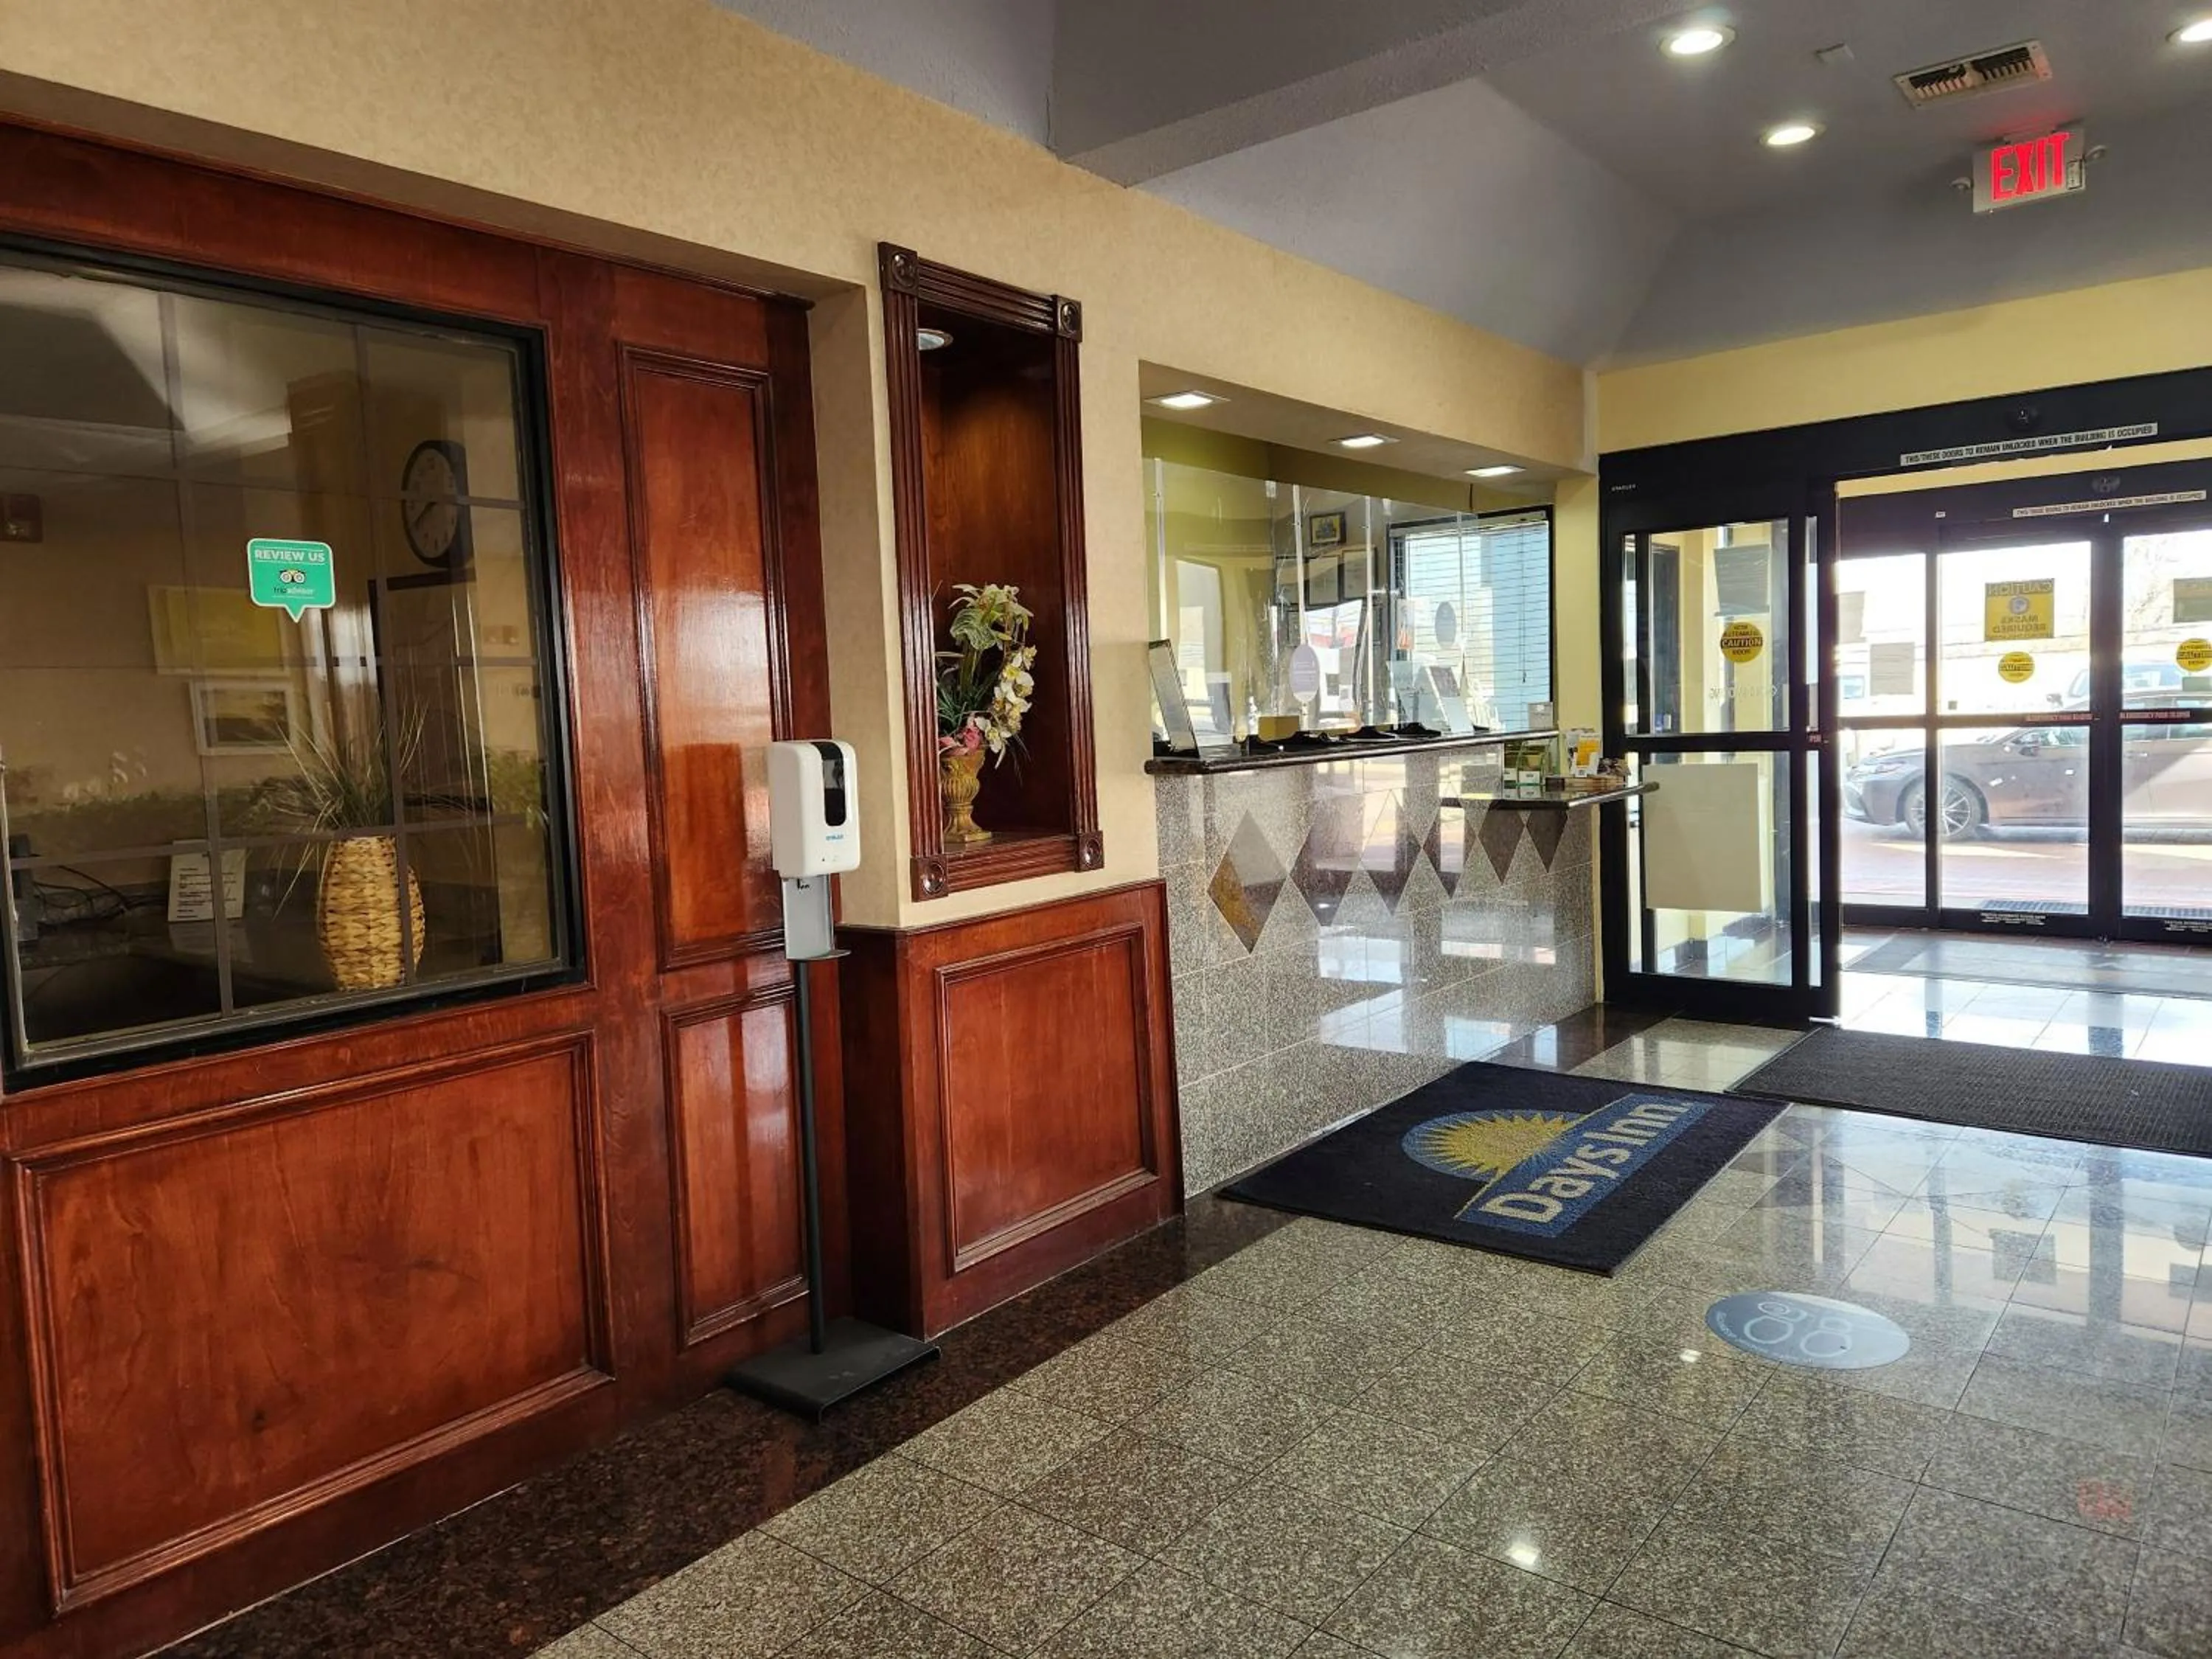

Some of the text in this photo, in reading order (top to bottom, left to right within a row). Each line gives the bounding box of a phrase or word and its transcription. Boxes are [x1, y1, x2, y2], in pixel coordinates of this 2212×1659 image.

[1991, 131, 2070, 202] EXIT
[1941, 449, 1964, 459] DOORS
[1965, 448, 1974, 456] TO
[1975, 445, 2000, 454] REMAIN
[2002, 440, 2035, 451] UNLOCKED
[2038, 437, 2058, 446] WHEN
[2061, 435, 2073, 444] THE
[2075, 431, 2107, 442] BUILDING
[2117, 425, 2153, 437] OCCUPIED
[254, 549, 325, 563] REVIEW US
[1722, 638, 1761, 647] CAUTION
